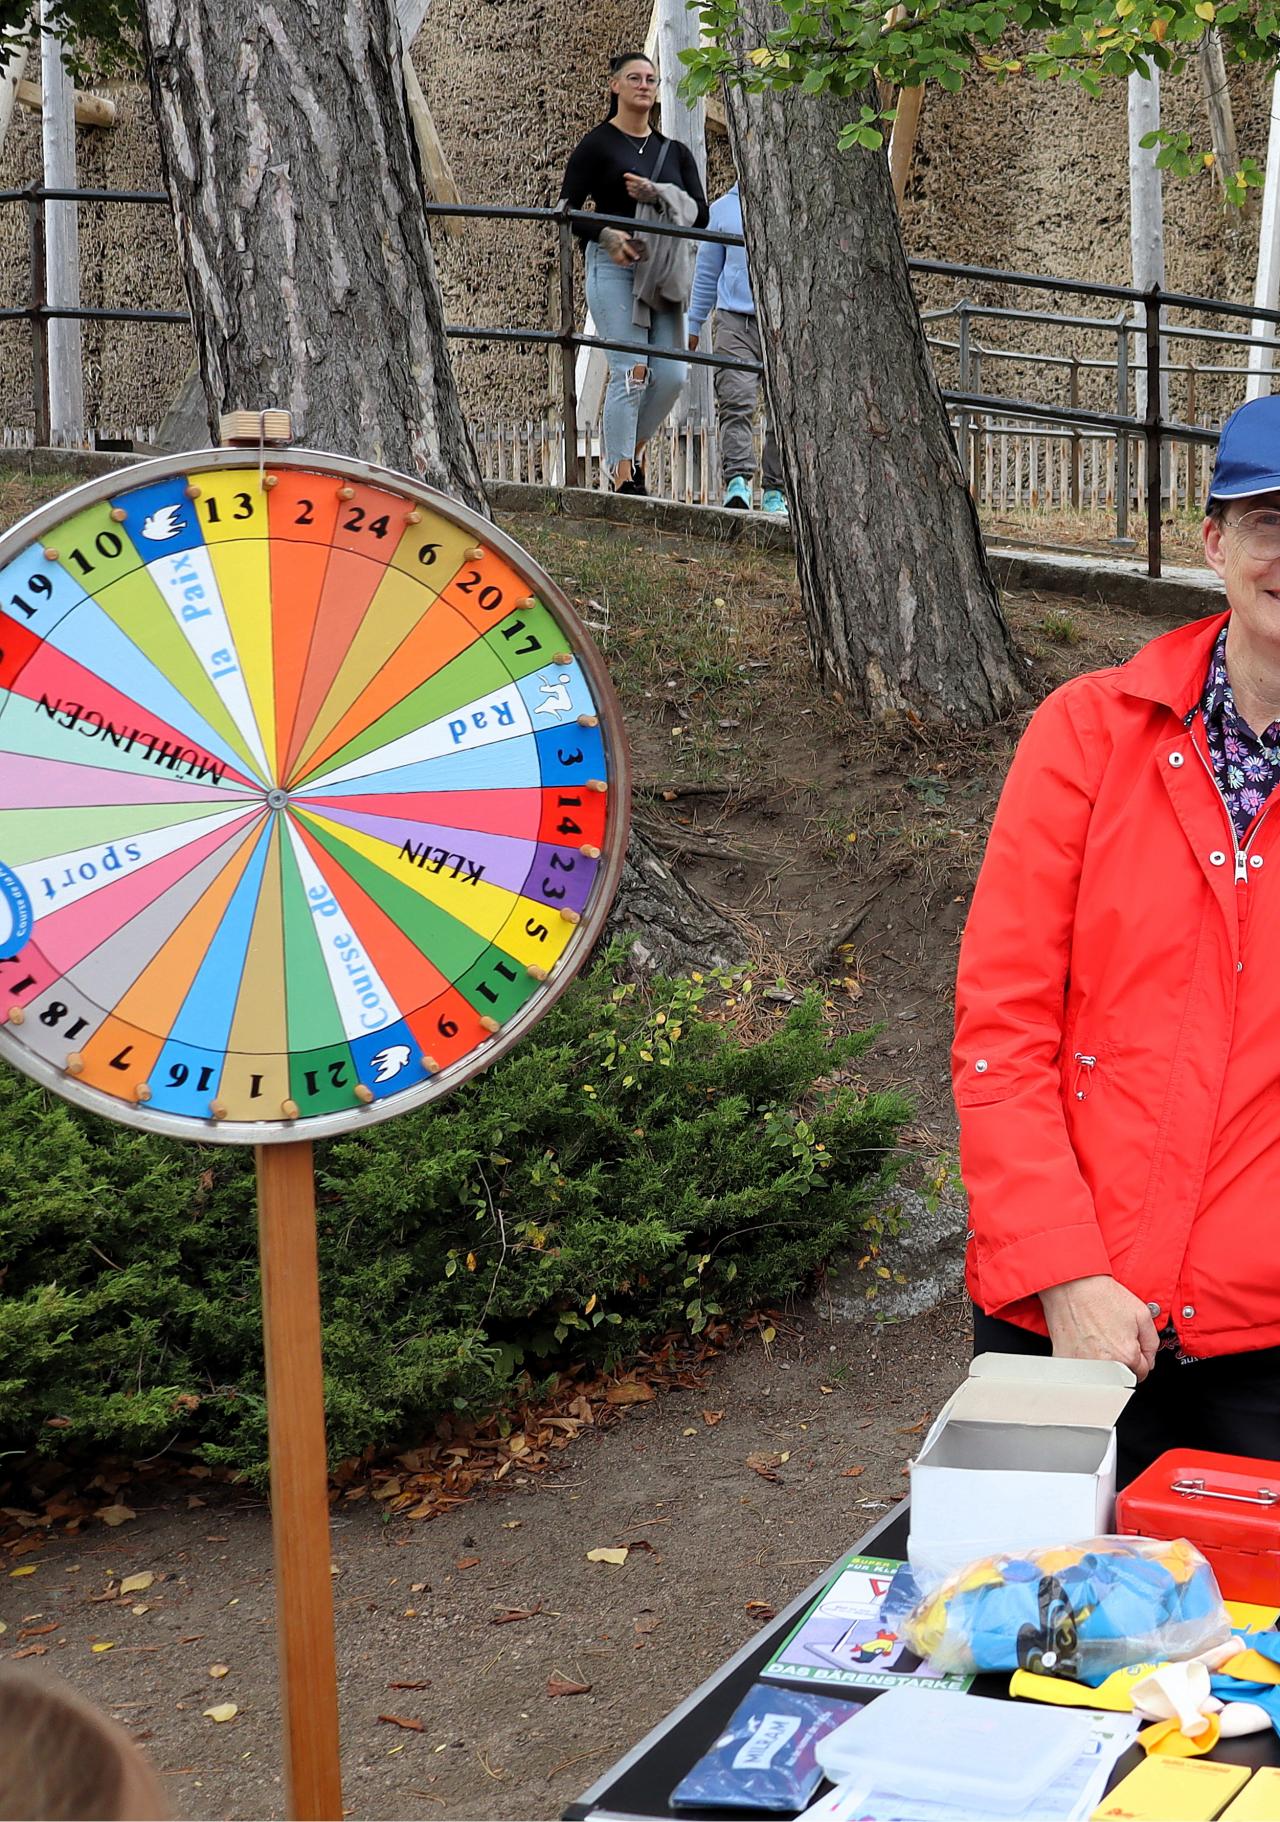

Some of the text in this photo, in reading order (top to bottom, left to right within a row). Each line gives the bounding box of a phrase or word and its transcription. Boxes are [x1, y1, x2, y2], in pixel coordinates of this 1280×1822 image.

[203, 492, 255, 523] 13
[295, 499, 314, 526] 2
[342, 507, 391, 540] 24
[66, 530, 123, 576] 10
[418, 543, 443, 566] 6
[10, 573, 54, 620] 19
[455, 570, 503, 610] 20
[500, 619, 542, 657] 17
[557, 747, 584, 767] 3
[35, 692, 487, 887] KLEIN MÜHLINGEN
[40, 700, 517, 900] Rad sport
[171, 555, 389, 1030] Course de la Paix
[556, 794, 584, 836] 14
[541, 853, 576, 900] 23
[524, 917, 549, 943] 5
[475, 960, 518, 1005] 11
[39, 1001, 91, 1041] 18
[436, 1013, 460, 1039] 9
[109, 1043, 134, 1069] 7
[165, 1063, 215, 1092] 16
[249, 1074, 264, 1099] 1
[303, 1060, 348, 1098] 21
[768, 1663, 963, 1691] DAS BÄRENSTARKE
